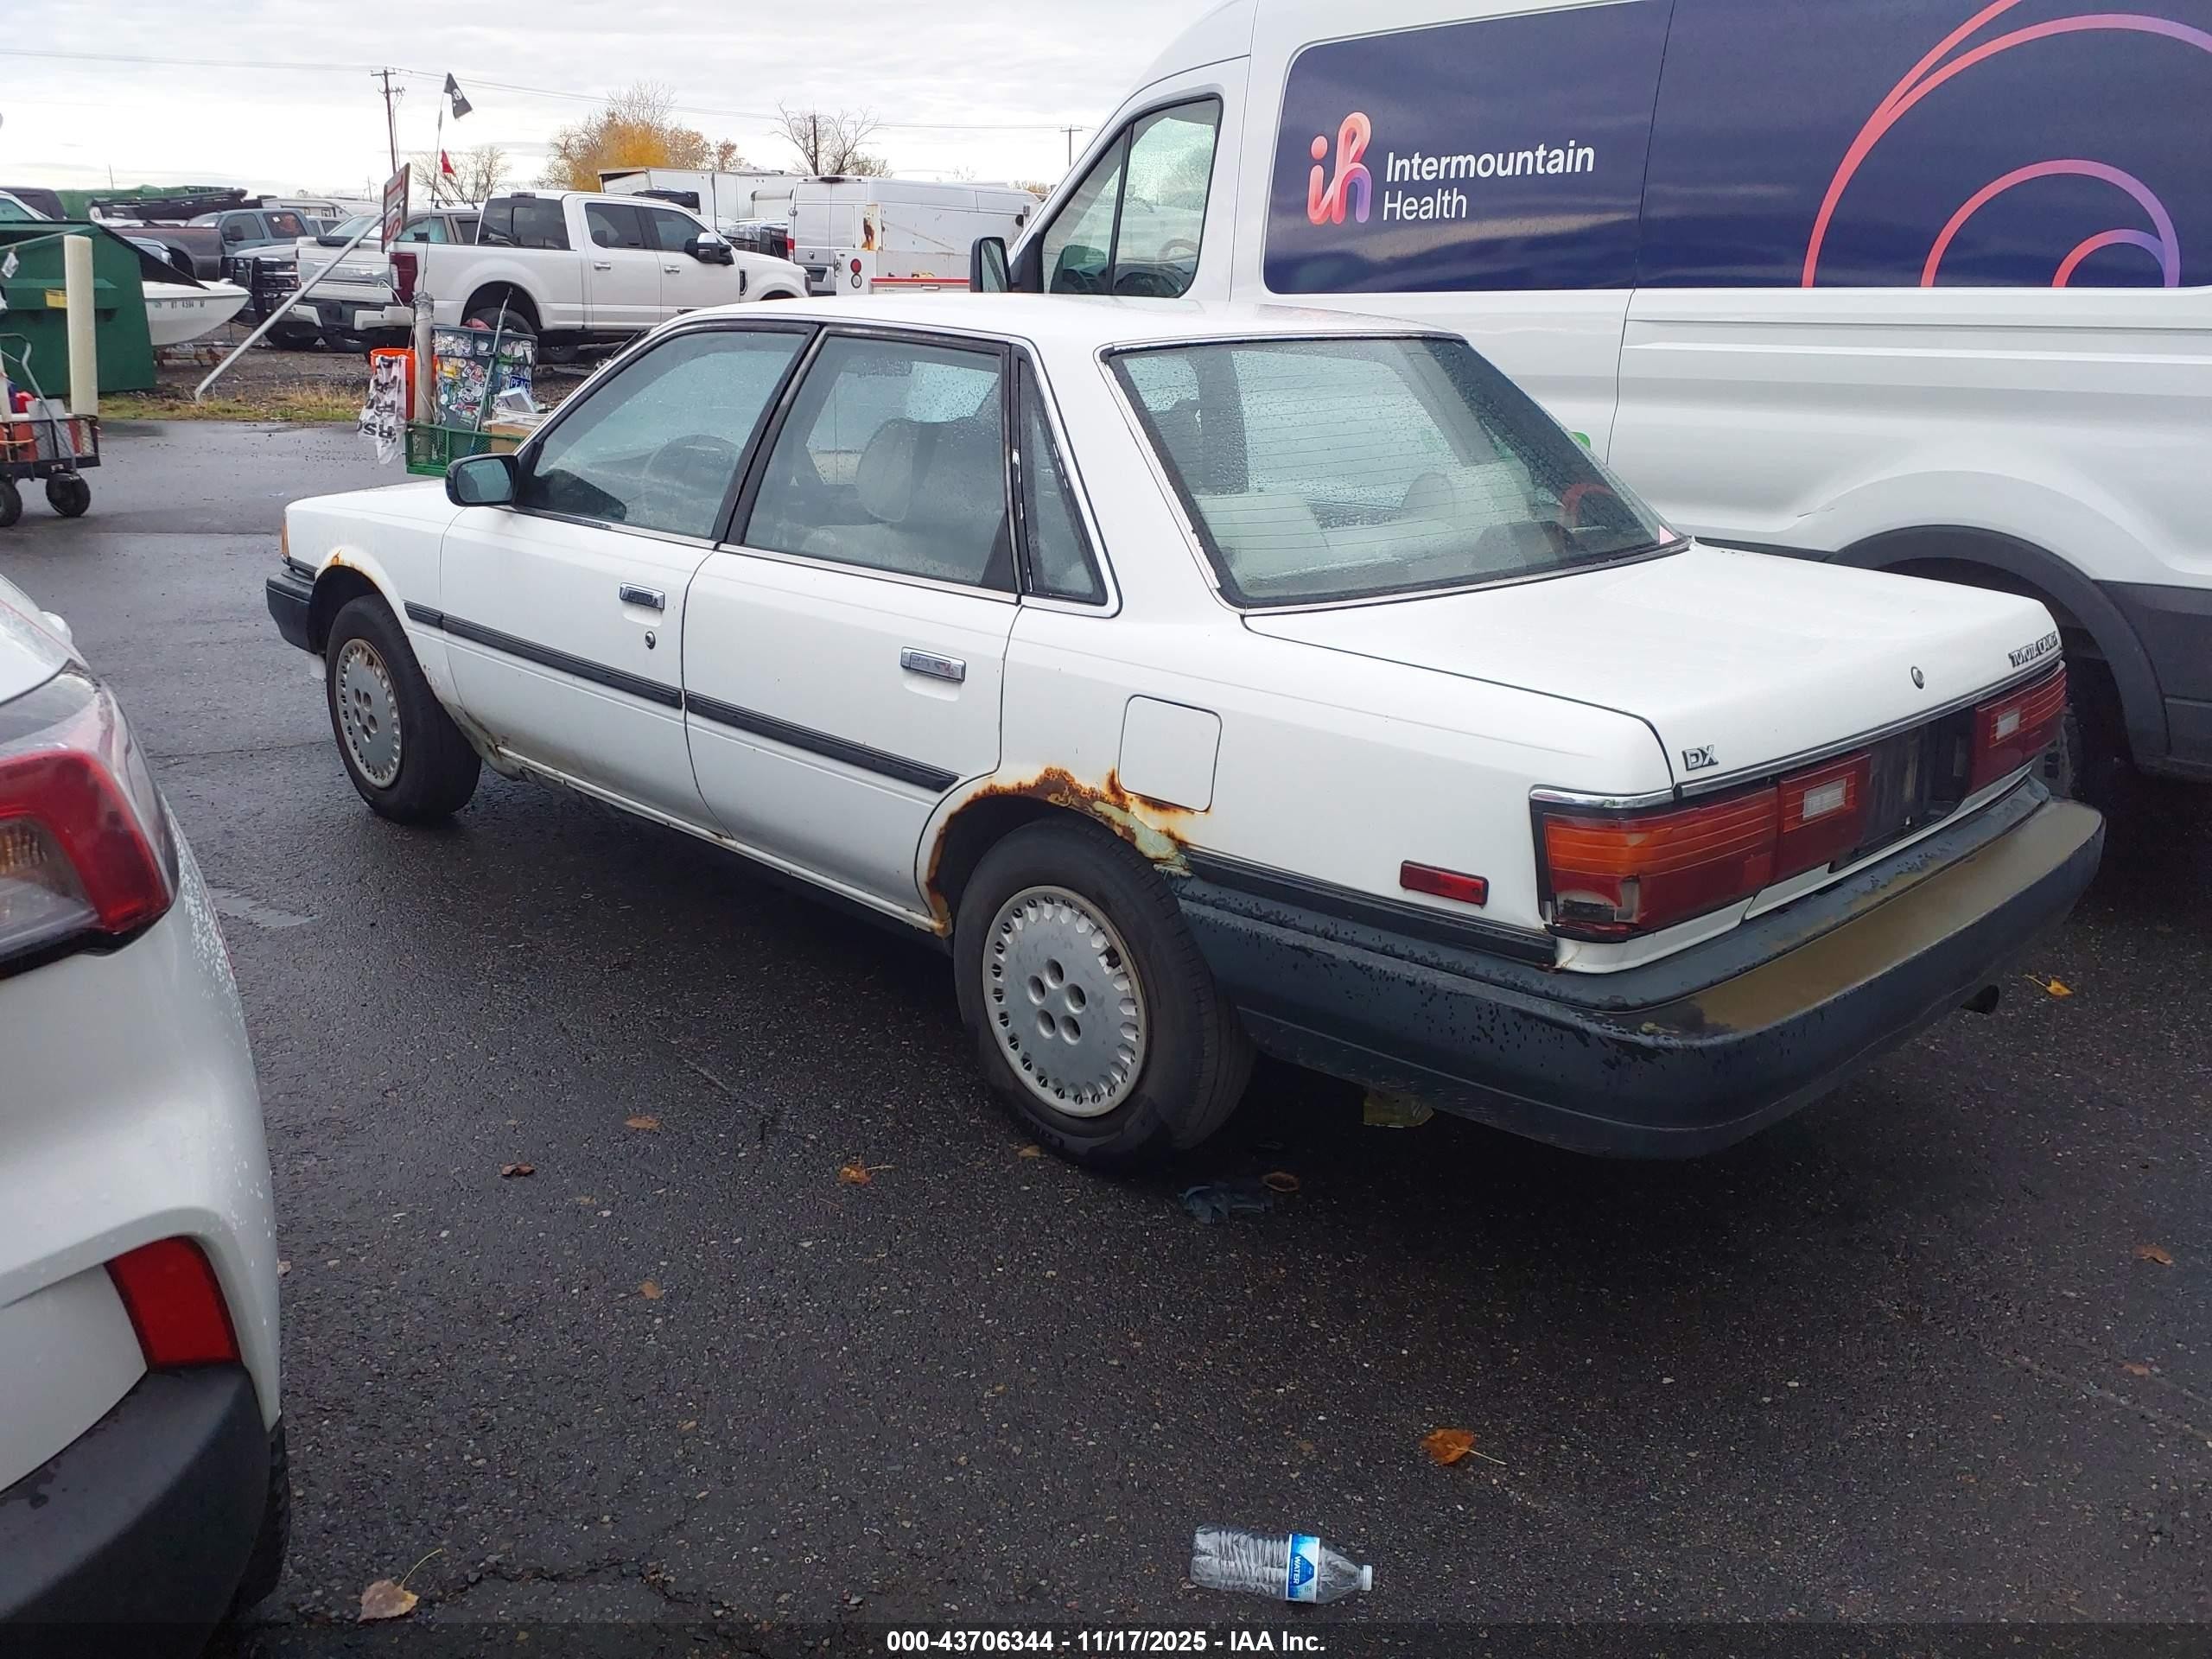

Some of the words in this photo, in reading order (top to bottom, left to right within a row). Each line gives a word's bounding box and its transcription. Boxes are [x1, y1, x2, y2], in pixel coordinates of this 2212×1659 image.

[1385, 139, 1595, 182] Intermountain
[1382, 187, 1467, 221] Health
[1681, 744, 1719, 772] DX
[1293, 1555, 1301, 1585] WATER
